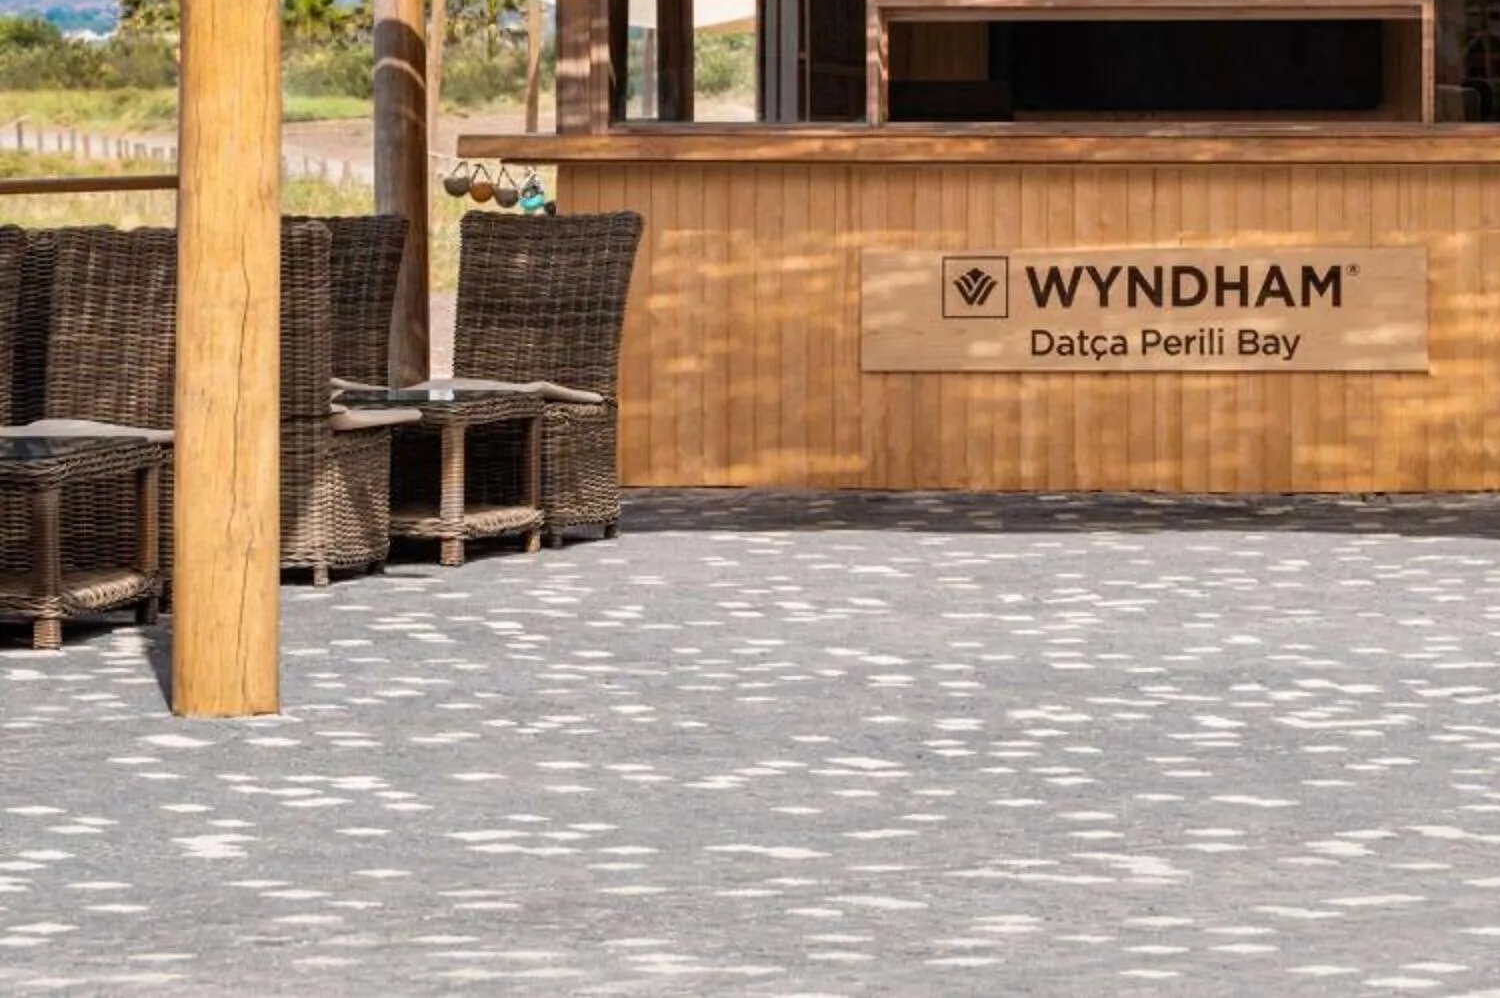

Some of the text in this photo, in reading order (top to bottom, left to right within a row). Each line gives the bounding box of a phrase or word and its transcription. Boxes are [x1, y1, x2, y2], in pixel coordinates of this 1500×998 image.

[1031, 328, 1301, 361] Datça Perili Bay
